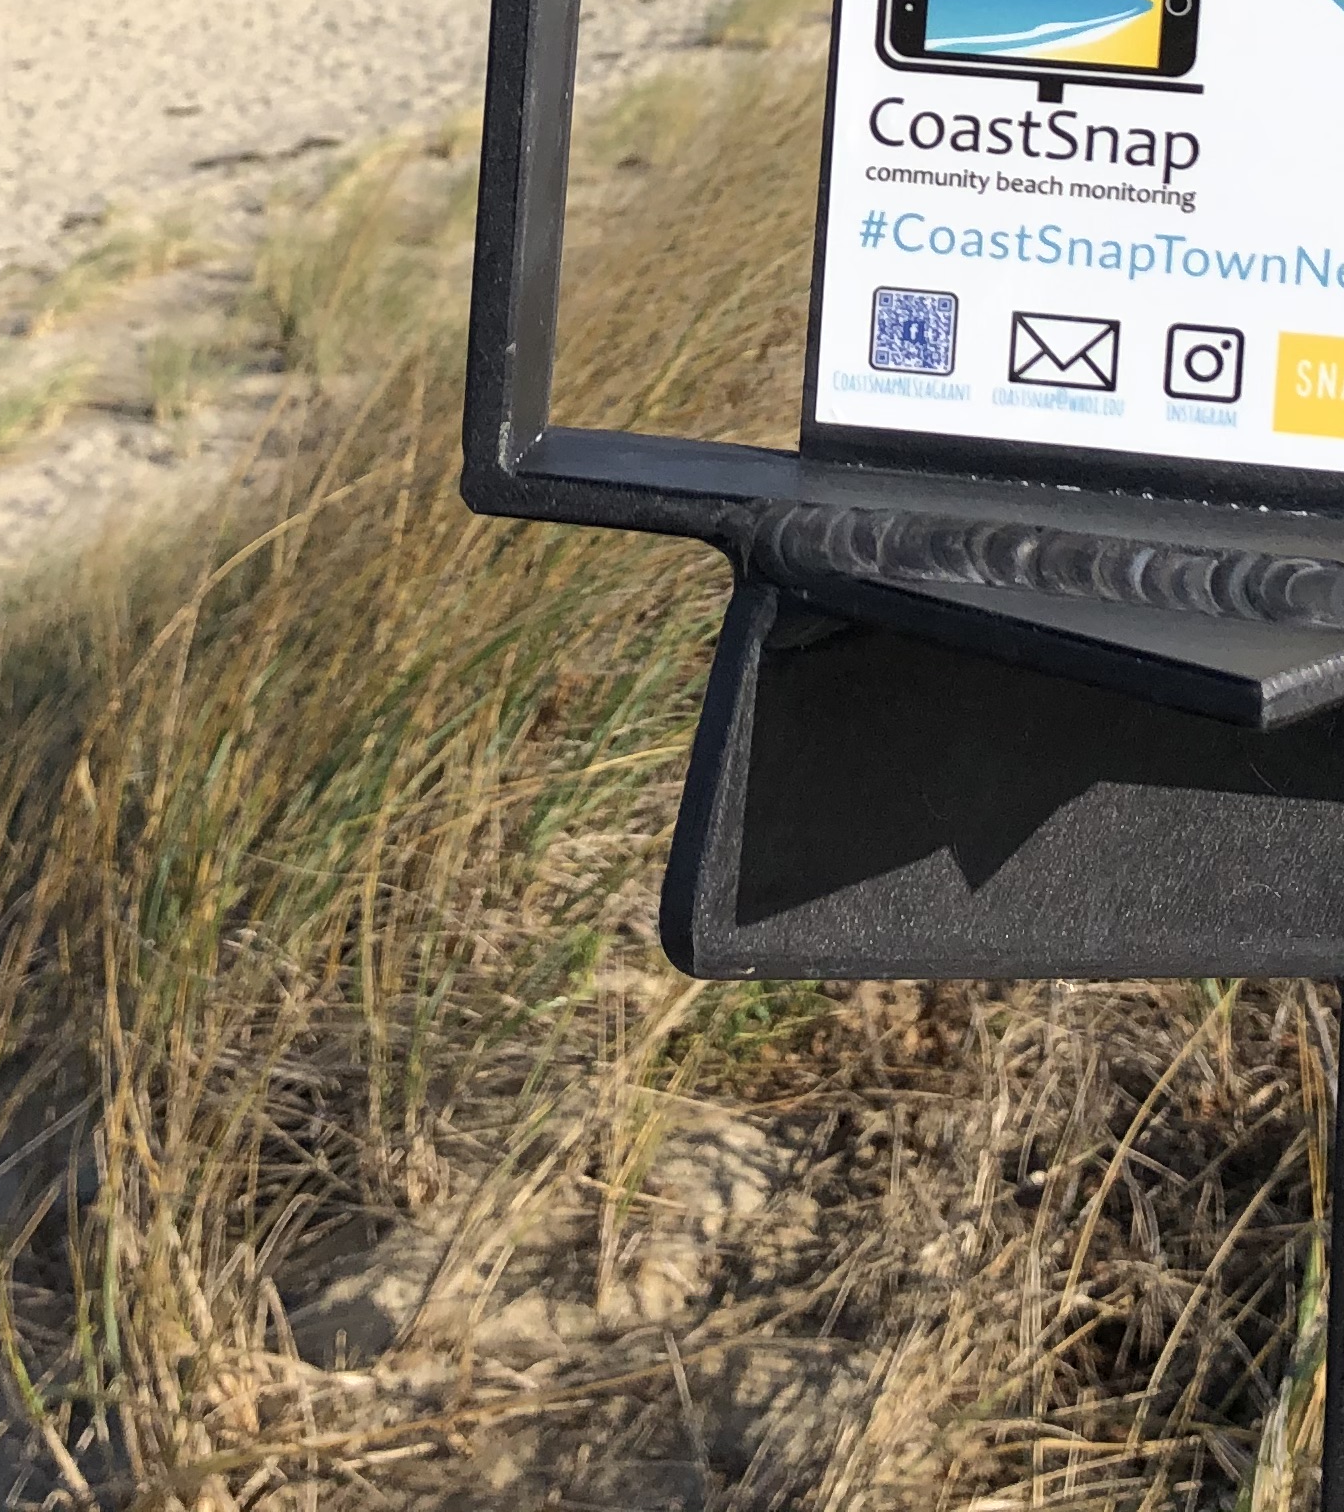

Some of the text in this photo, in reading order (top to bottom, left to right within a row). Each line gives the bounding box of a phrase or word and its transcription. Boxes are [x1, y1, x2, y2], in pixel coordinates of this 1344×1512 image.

[869, 97, 1200, 184] CoastSnap
[865, 164, 1196, 213] community beach monitoring
